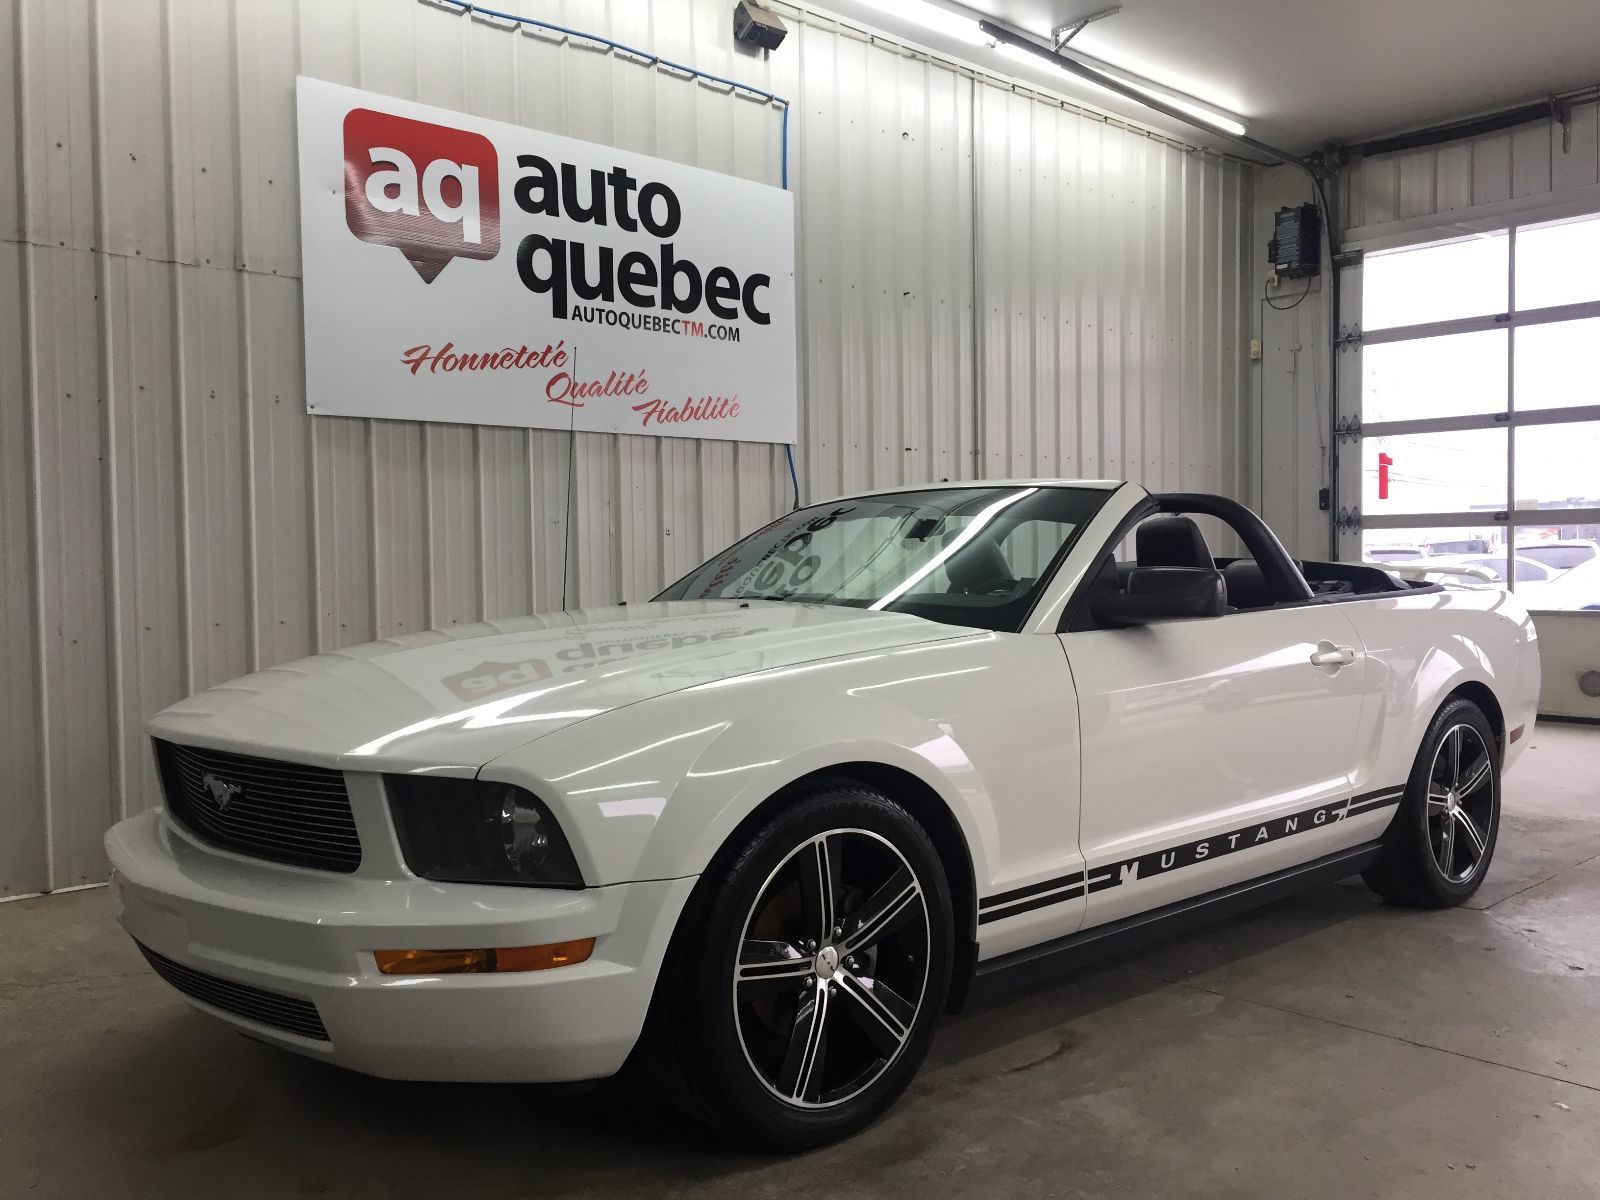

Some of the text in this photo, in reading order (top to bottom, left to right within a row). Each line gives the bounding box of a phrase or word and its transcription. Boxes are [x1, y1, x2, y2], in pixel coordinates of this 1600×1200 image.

[364, 146, 482, 245] aq
[514, 154, 681, 239] auto
[516, 233, 771, 326] quebec
[572, 304, 741, 342] AUTOQUEBECTM.COM
[545, 368, 650, 408] Qualité
[631, 393, 742, 427] Fiabilité
[1119, 809, 1326, 885] MUSTANG
